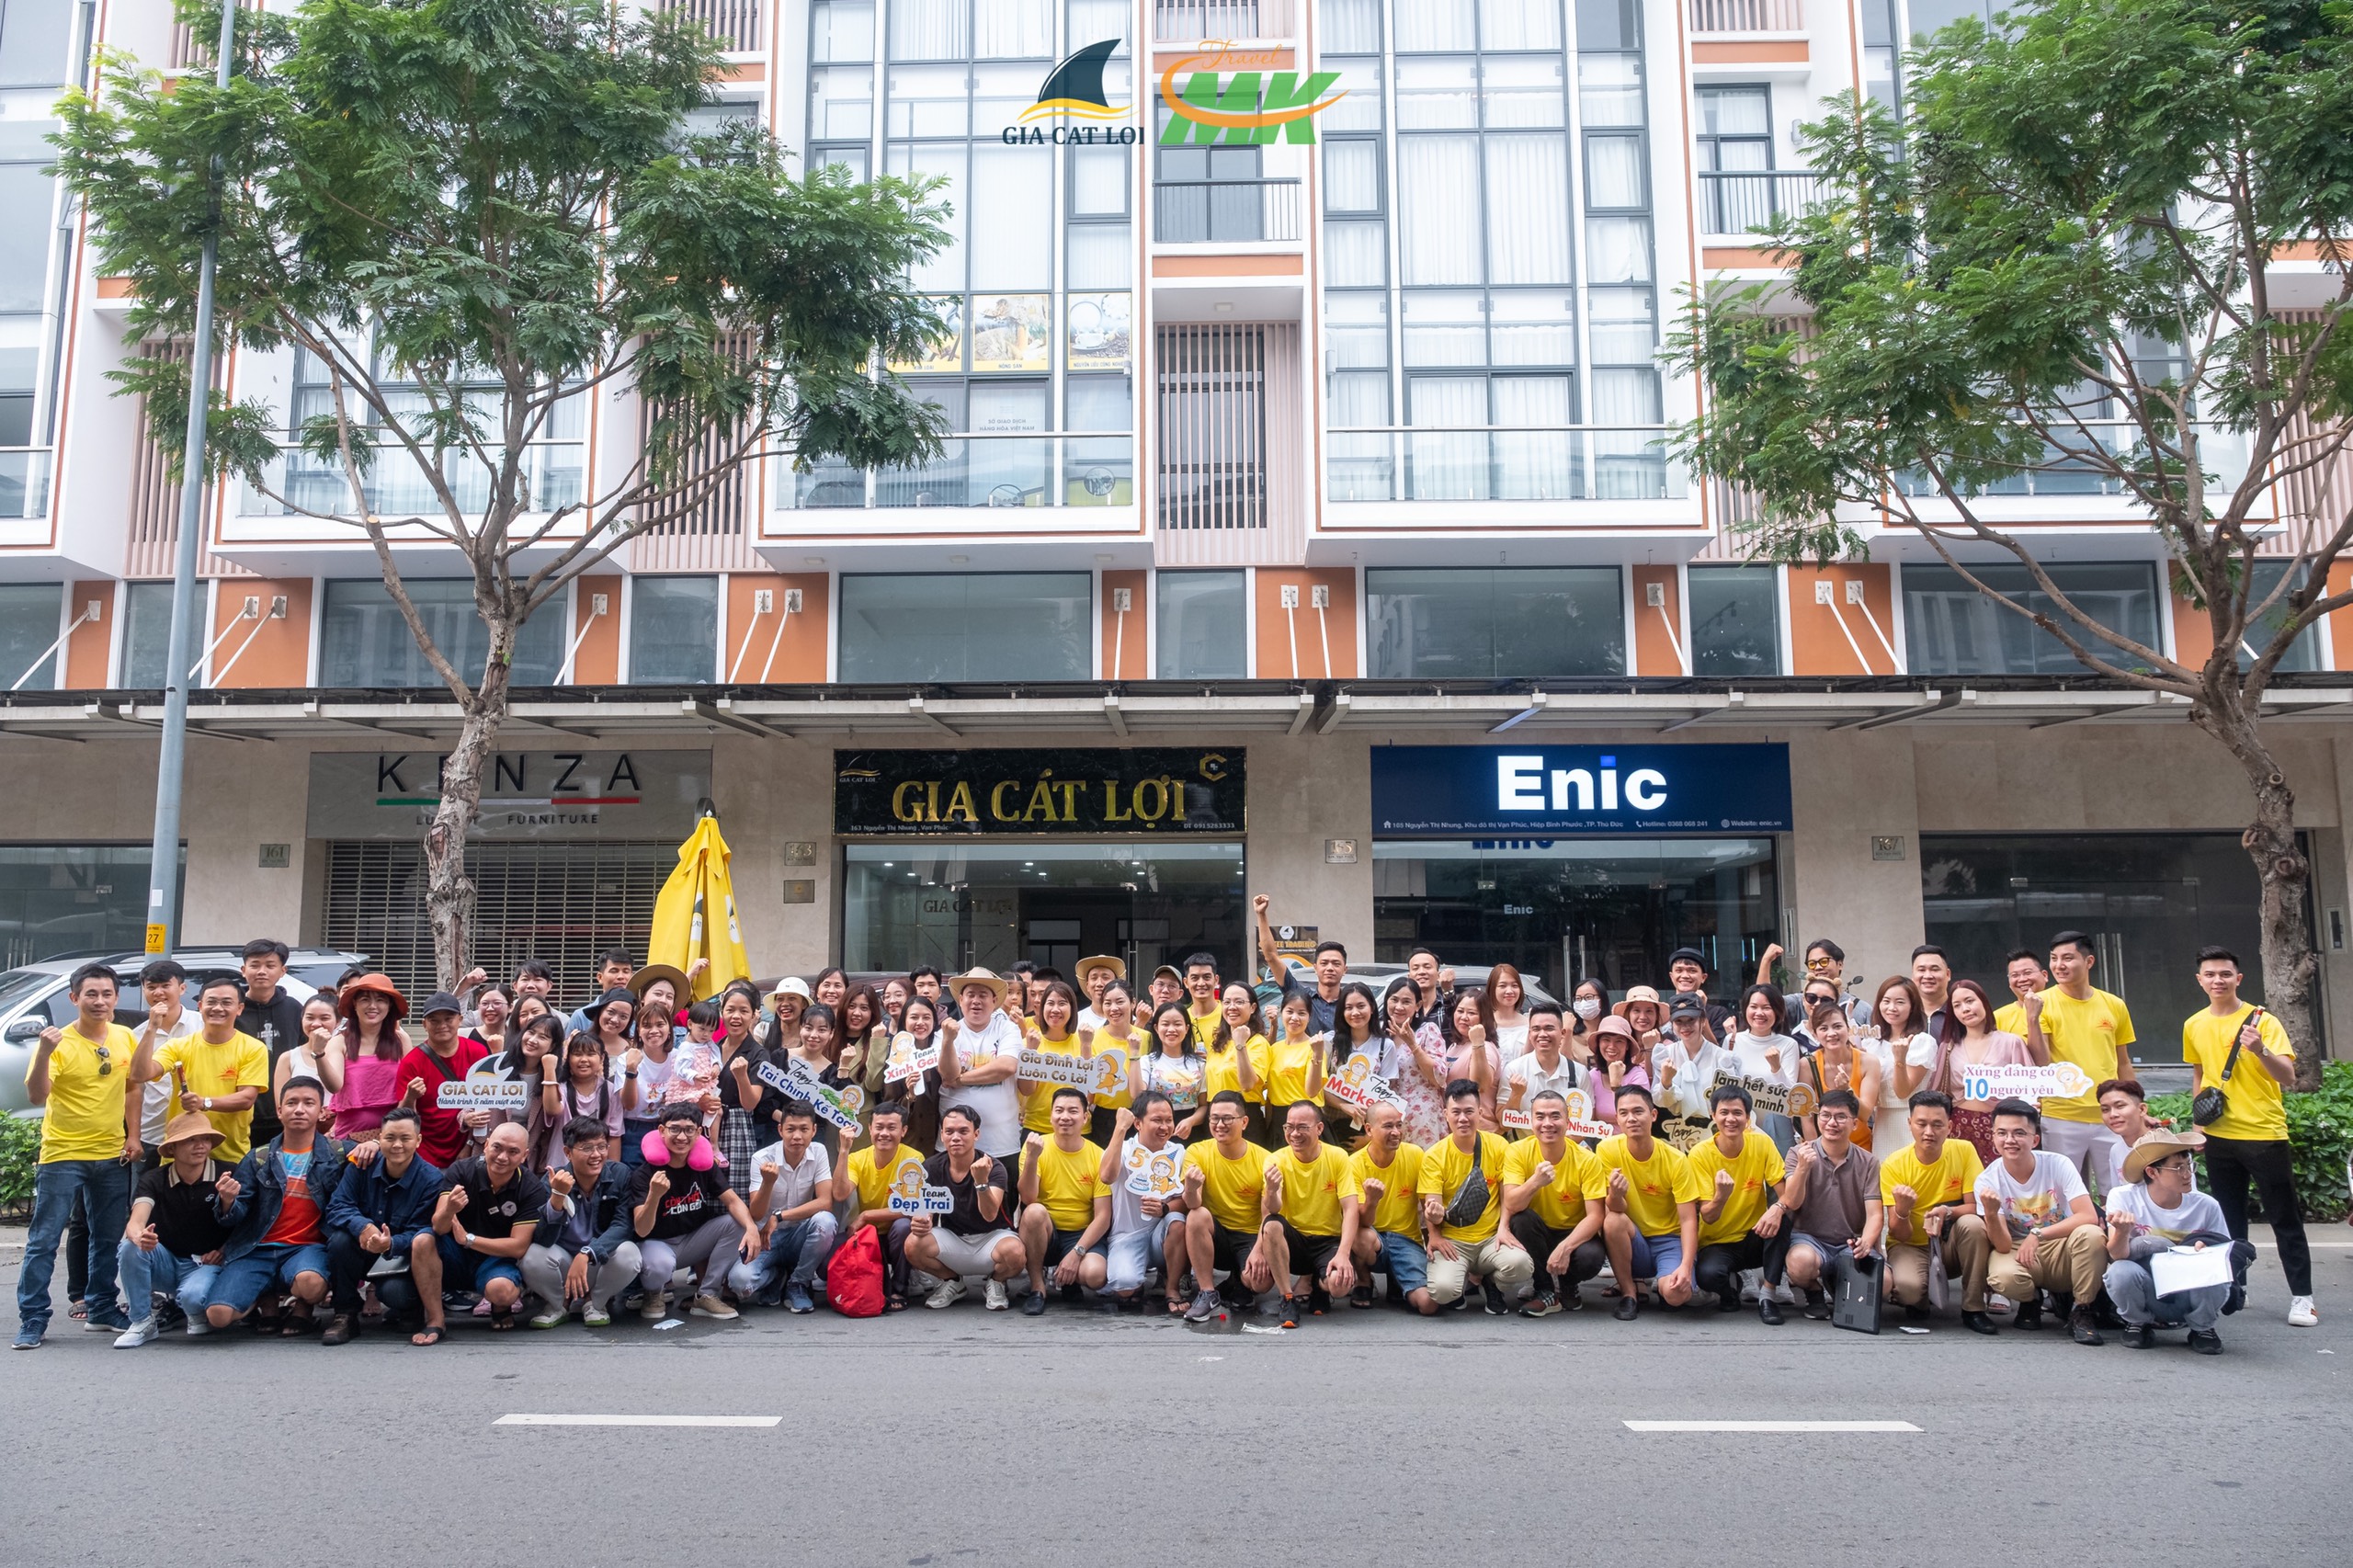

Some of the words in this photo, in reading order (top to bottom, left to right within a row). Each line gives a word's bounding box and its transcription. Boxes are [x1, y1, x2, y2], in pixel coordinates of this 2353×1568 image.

[1497, 755, 1668, 811] Enic
[892, 779, 979, 824] GIA
[991, 768, 1086, 823] CÁT
[1104, 774, 1188, 829] LỢI
[507, 813, 600, 824] FURNITURE
[266, 846, 284, 858] 161
[923, 900, 949, 913] GIA
[1504, 904, 1533, 915] Enic
[147, 933, 160, 944] 27
[913, 1048, 936, 1060] Team
[886, 1063, 914, 1081] Xinh
[916, 1053, 938, 1069] Gái
[1019, 1051, 1041, 1064] Gia
[1044, 1054, 1074, 1069] Đình
[1076, 1059, 1094, 1073] Lợi
[759, 1063, 779, 1084] Tài
[1018, 1066, 1048, 1079] Luôn
[1051, 1070, 1067, 1082] Có
[1070, 1072, 1088, 1085] Lời
[1966, 1065, 2001, 1079] Xứng
[2004, 1066, 2038, 1079] đáng
[2040, 1066, 2055, 1077] có
[442, 1084, 468, 1096] GIA
[472, 1085, 498, 1096] CAT
[501, 1085, 523, 1096] LOI
[1714, 1071, 1739, 1087] làm
[1743, 1074, 1765, 1093] hết
[1767, 1083, 1789, 1098] sức
[1964, 1078, 1989, 1099] 10
[1990, 1085, 2029, 1096] người
[2031, 1085, 2054, 1097] yêu
[438, 1097, 456, 1106] Hành
[1754, 1096, 1785, 1114] mình
[921, 1187, 948, 1198] Team
[892, 1198, 919, 1212] Đẹp
[924, 1198, 950, 1210] Trai
